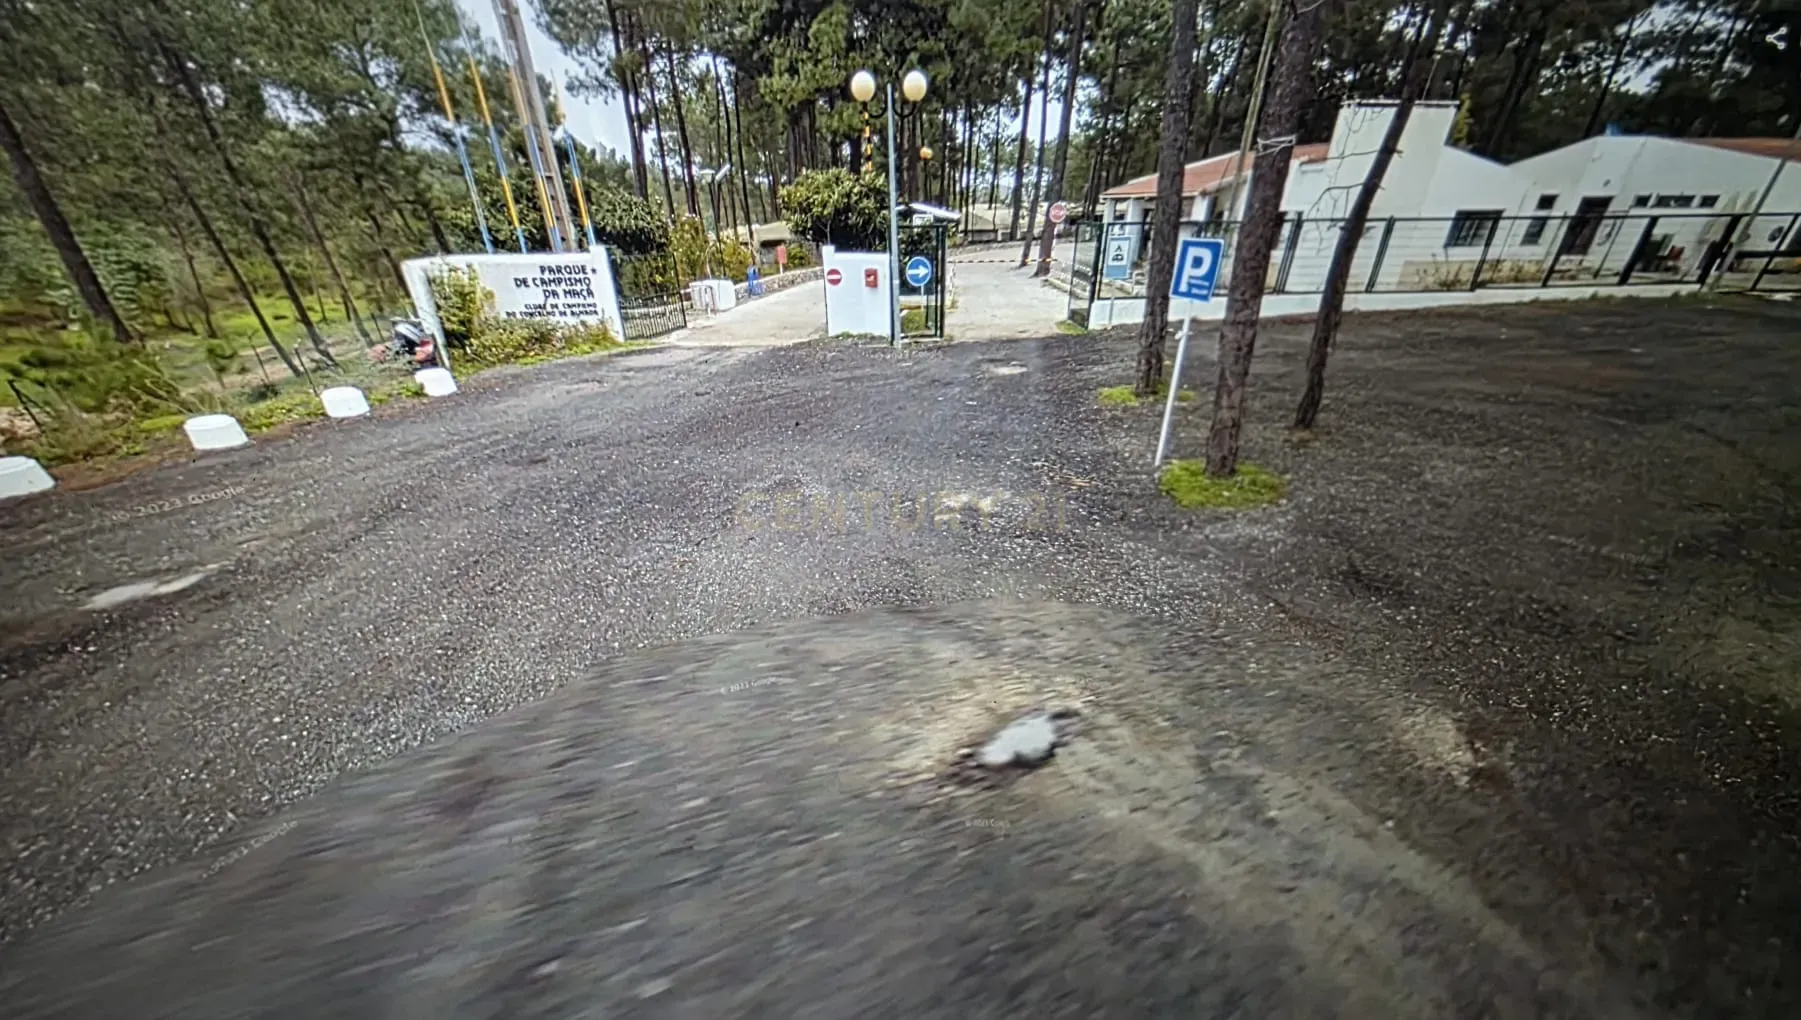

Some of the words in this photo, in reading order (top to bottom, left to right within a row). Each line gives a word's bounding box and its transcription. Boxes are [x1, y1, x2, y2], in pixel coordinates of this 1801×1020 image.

[539, 264, 588, 276] PARQUE
[1178, 246, 1212, 293] P
[513, 277, 530, 288] DE
[532, 276, 592, 288] CAMPISMO
[542, 289, 560, 300] DA
